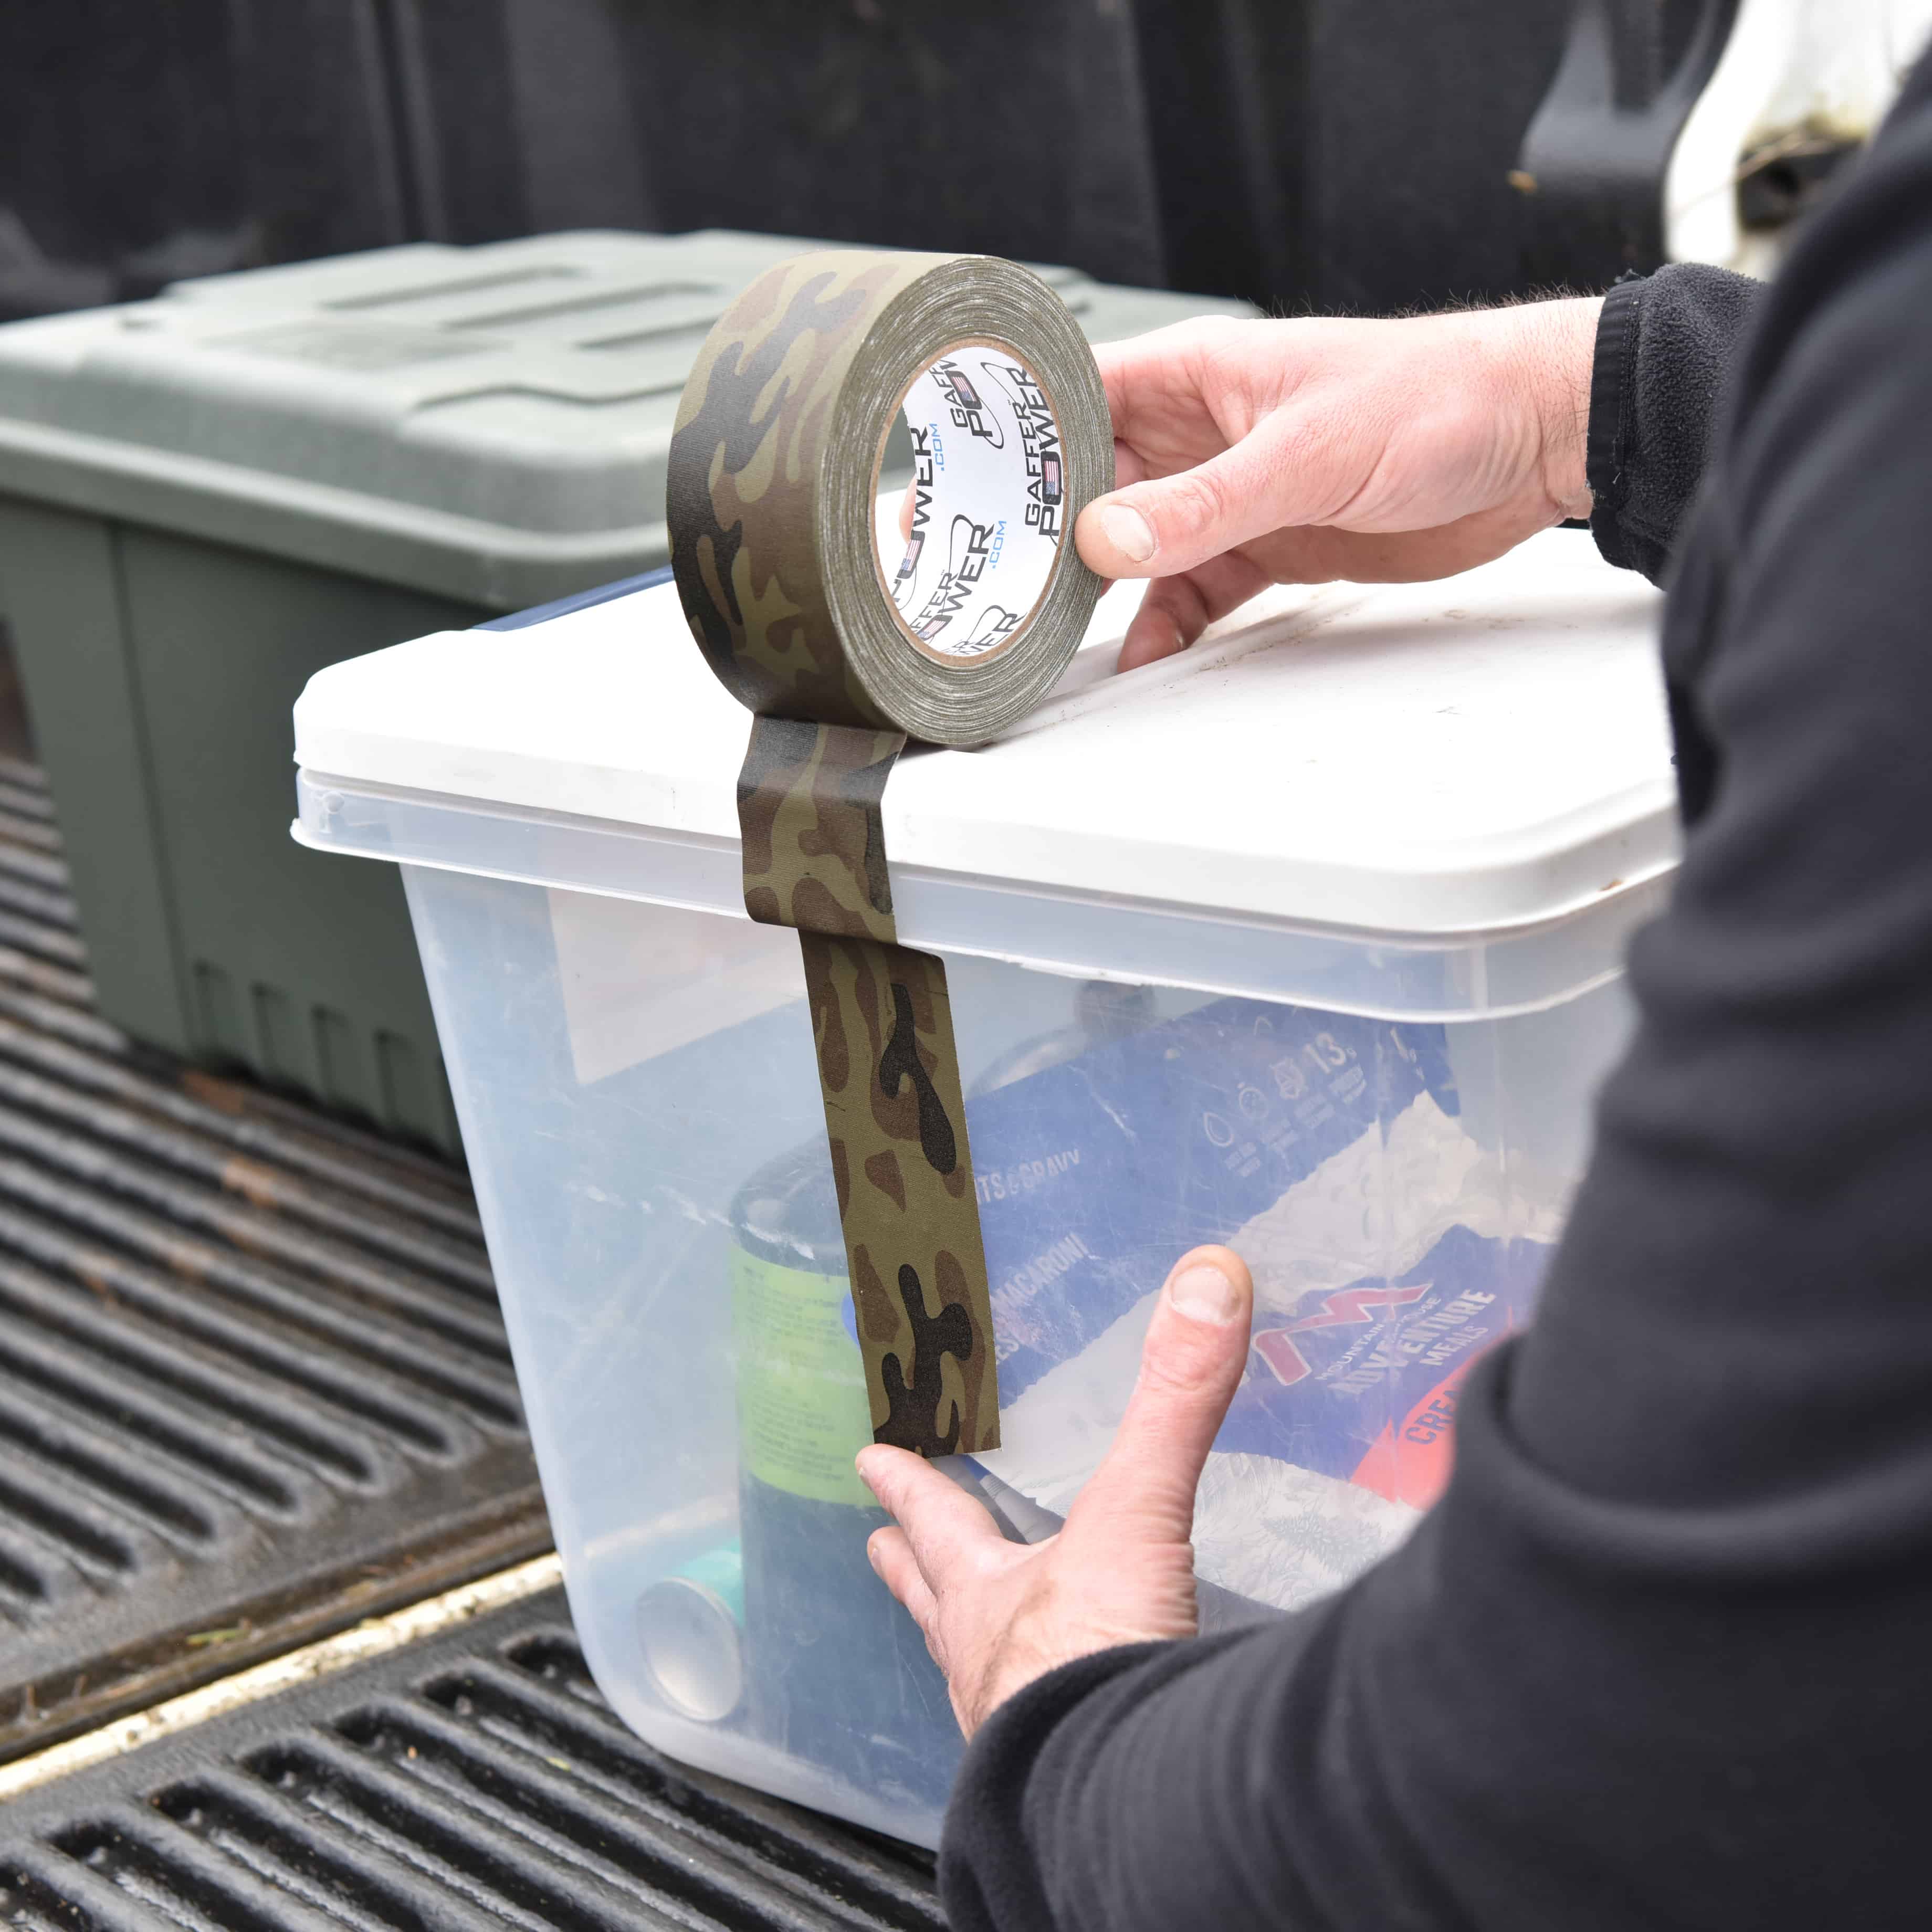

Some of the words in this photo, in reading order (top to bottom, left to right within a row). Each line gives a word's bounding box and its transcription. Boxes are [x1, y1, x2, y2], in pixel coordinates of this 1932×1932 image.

[929, 423, 945, 471] .COM
[1012, 402, 1042, 526] GAFFER
[989, 520, 1007, 569] .COM
[1419, 1325, 1489, 1366] MEALS
